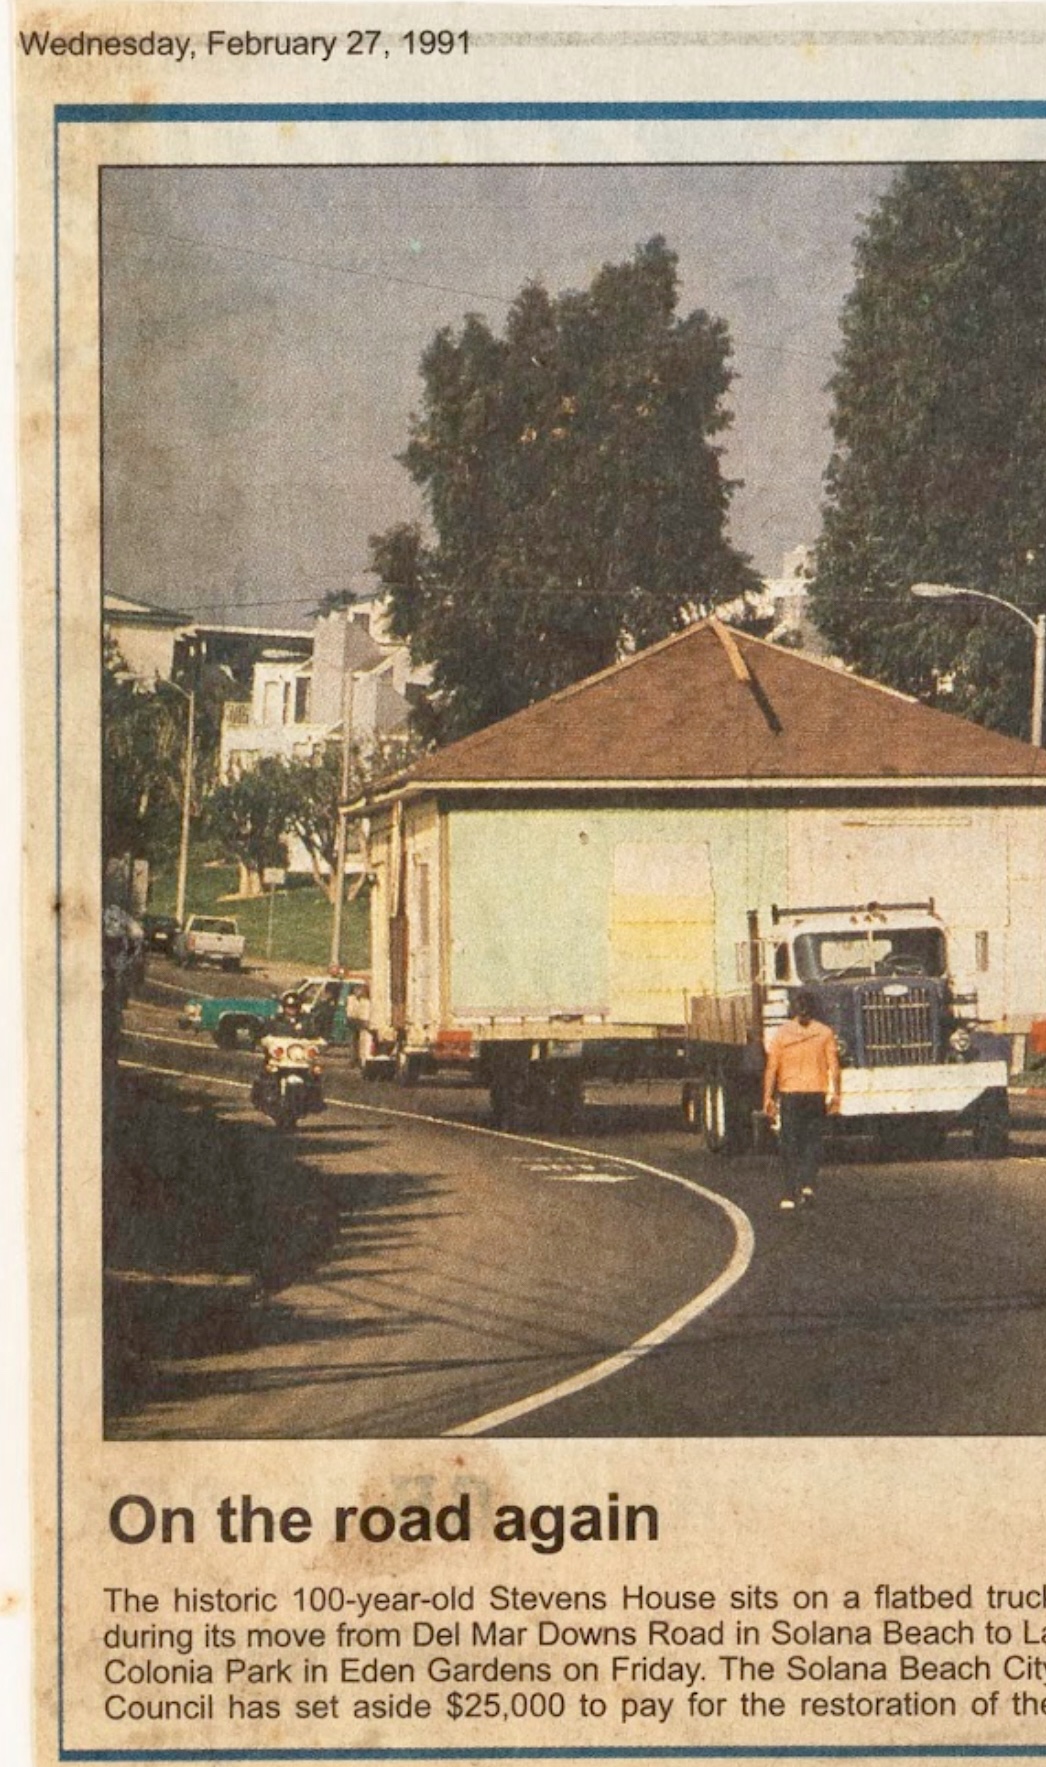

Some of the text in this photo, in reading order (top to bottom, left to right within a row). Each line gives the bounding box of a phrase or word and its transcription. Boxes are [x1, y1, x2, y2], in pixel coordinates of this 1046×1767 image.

[18, 29, 472, 61] Wednesday, February 27, 1991
[108, 1493, 195, 1545] On
[216, 1493, 313, 1545] the
[335, 1492, 471, 1544] road
[493, 1491, 659, 1554] again
[102, 1587, 160, 1613] The
[173, 1586, 278, 1613] historic
[293, 1585, 475, 1617] 100-year-old
[489, 1584, 608, 1611] Stevens
[622, 1584, 717, 1611] House
[729, 1584, 779, 1611] sits
[792, 1589, 829, 1610] on
[842, 1589, 861, 1610] a
[873, 1583, 973, 1610] flatbed
[102, 1623, 193, 1655] during
[204, 1622, 237, 1649] its
[247, 1628, 326, 1648] move
[335, 1620, 401, 1648] from
[413, 1621, 460, 1648] Del
[471, 1620, 528, 1647] Mar
[538, 1620, 637, 1647] Downs
[648, 1619, 724, 1646] Road
[736, 1619, 760, 1646] in
[771, 1619, 872, 1646] Solana
[883, 1619, 975, 1646] Beach
[984, 1620, 1013, 1645] to
[104, 1658, 213, 1685] Colonia
[225, 1658, 293, 1684] Park
[304, 1657, 328, 1684] in
[340, 1657, 415, 1684] Eden
[427, 1656, 552, 1683] Gardens
[562, 1662, 599, 1682] on
[612, 1655, 706, 1688] Friday.
[718, 1655, 775, 1682] The
[786, 1655, 887, 1681] Solana
[899, 1654, 991, 1681] Beach
[104, 1694, 214, 1721] Council
[228, 1693, 281, 1720] has
[295, 1695, 340, 1720] set
[353, 1693, 432, 1719] aside
[446, 1690, 566, 1722] $25,000
[578, 1693, 608, 1718] to
[621, 1697, 675, 1724] pay
[687, 1691, 728, 1718] for
[739, 1691, 786, 1718] the
[800, 1691, 957, 1717] restoration
[970, 1690, 1000, 1717] of
